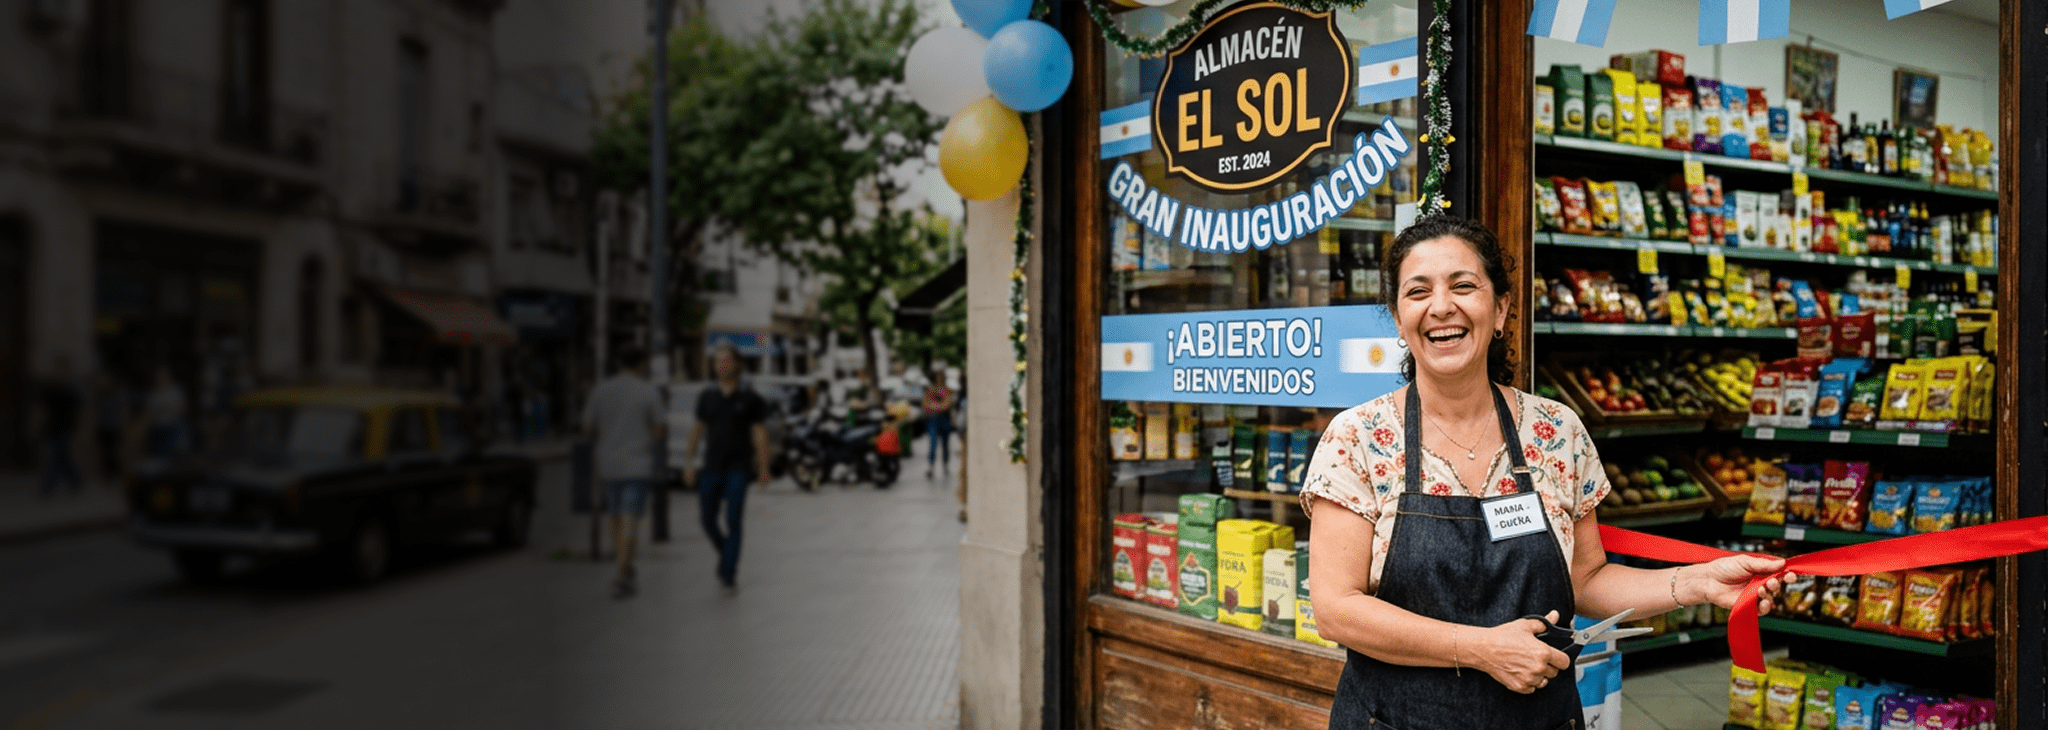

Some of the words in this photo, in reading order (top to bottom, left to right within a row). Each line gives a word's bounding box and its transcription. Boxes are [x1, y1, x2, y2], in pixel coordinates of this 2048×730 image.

[1195, 17, 1303, 81] ALMACÉN
[1178, 88, 1224, 153] EL
[1236, 67, 1321, 142] SOL
[1108, 161, 1179, 239] GRAN
[1179, 117, 1411, 251] INAUGURACIÓN
[1218, 156, 1241, 173] EST.
[1243, 150, 1271, 170] 2024
[1166, 318, 1323, 364] ¡ABIERTO!
[1173, 368, 1316, 395] BIENVENIDOS
